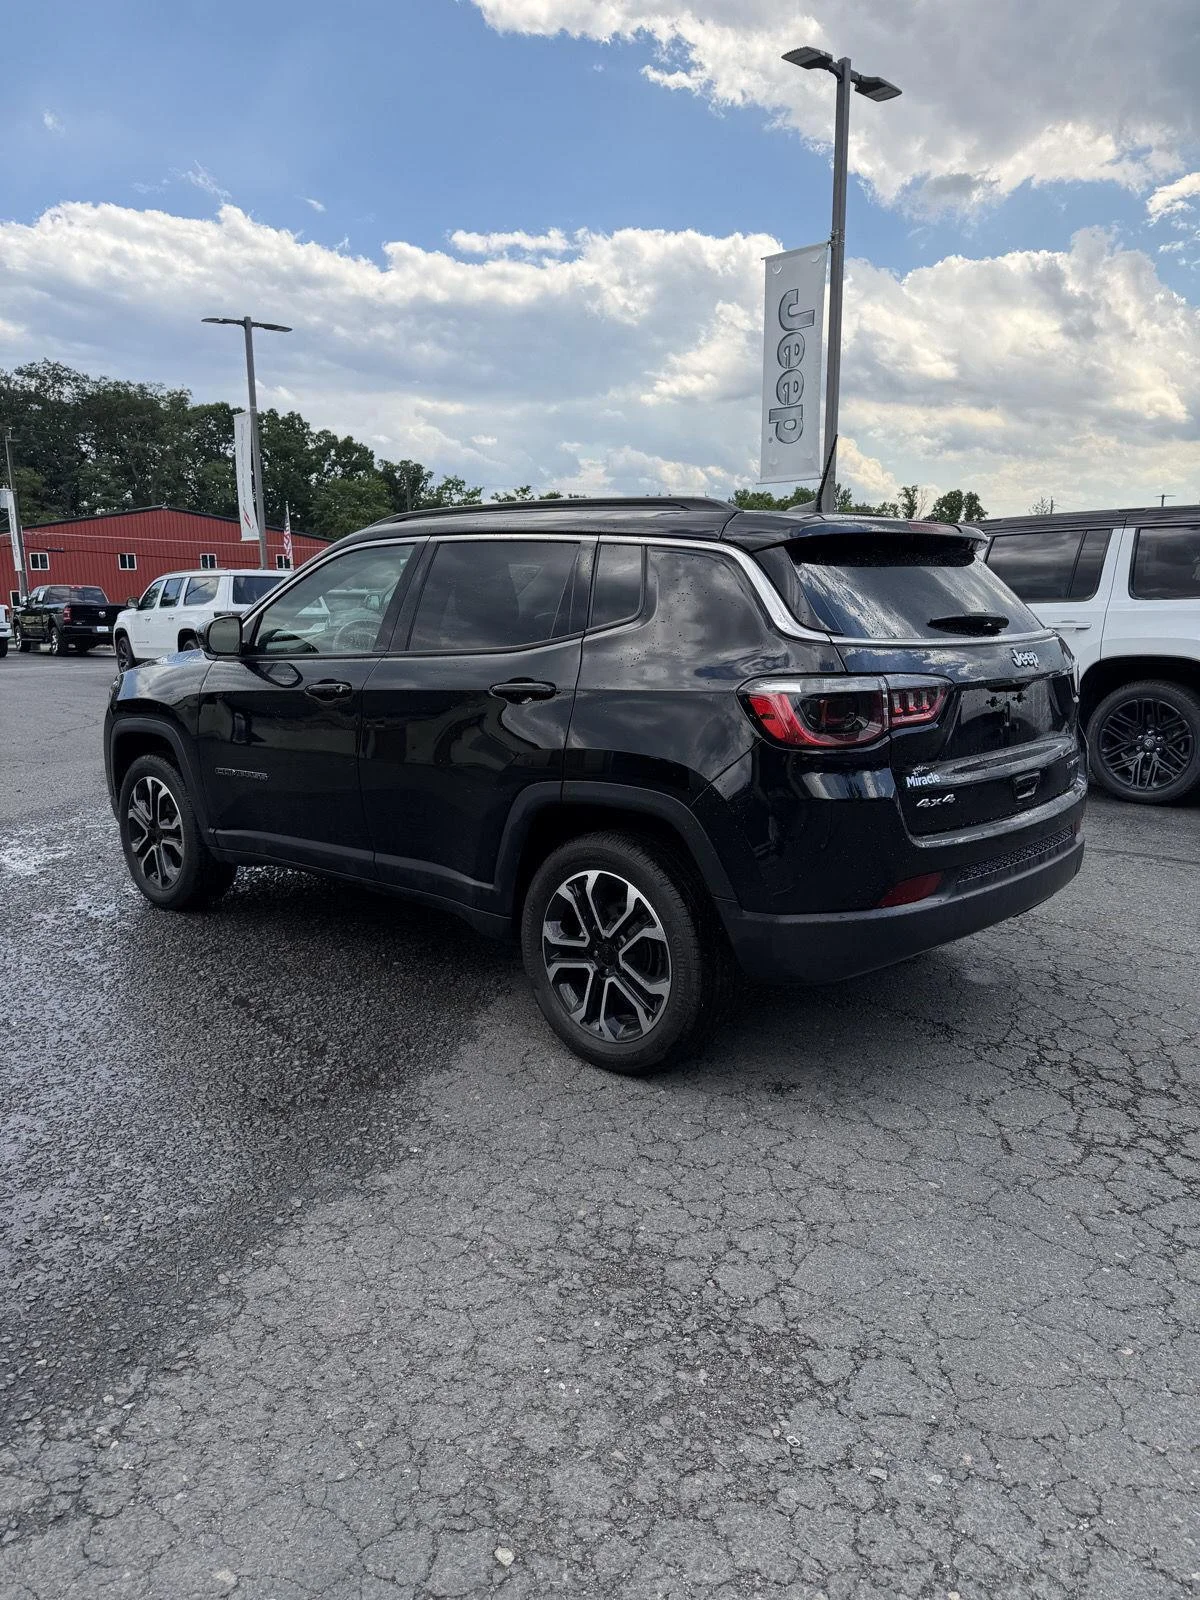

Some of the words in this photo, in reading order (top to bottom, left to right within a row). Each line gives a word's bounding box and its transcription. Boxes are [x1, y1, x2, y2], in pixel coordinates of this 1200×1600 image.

[769, 288, 815, 444] Jeep
[1010, 648, 1039, 669] Jeep
[906, 772, 941, 788] Miracle
[916, 793, 956, 807] 4x4
